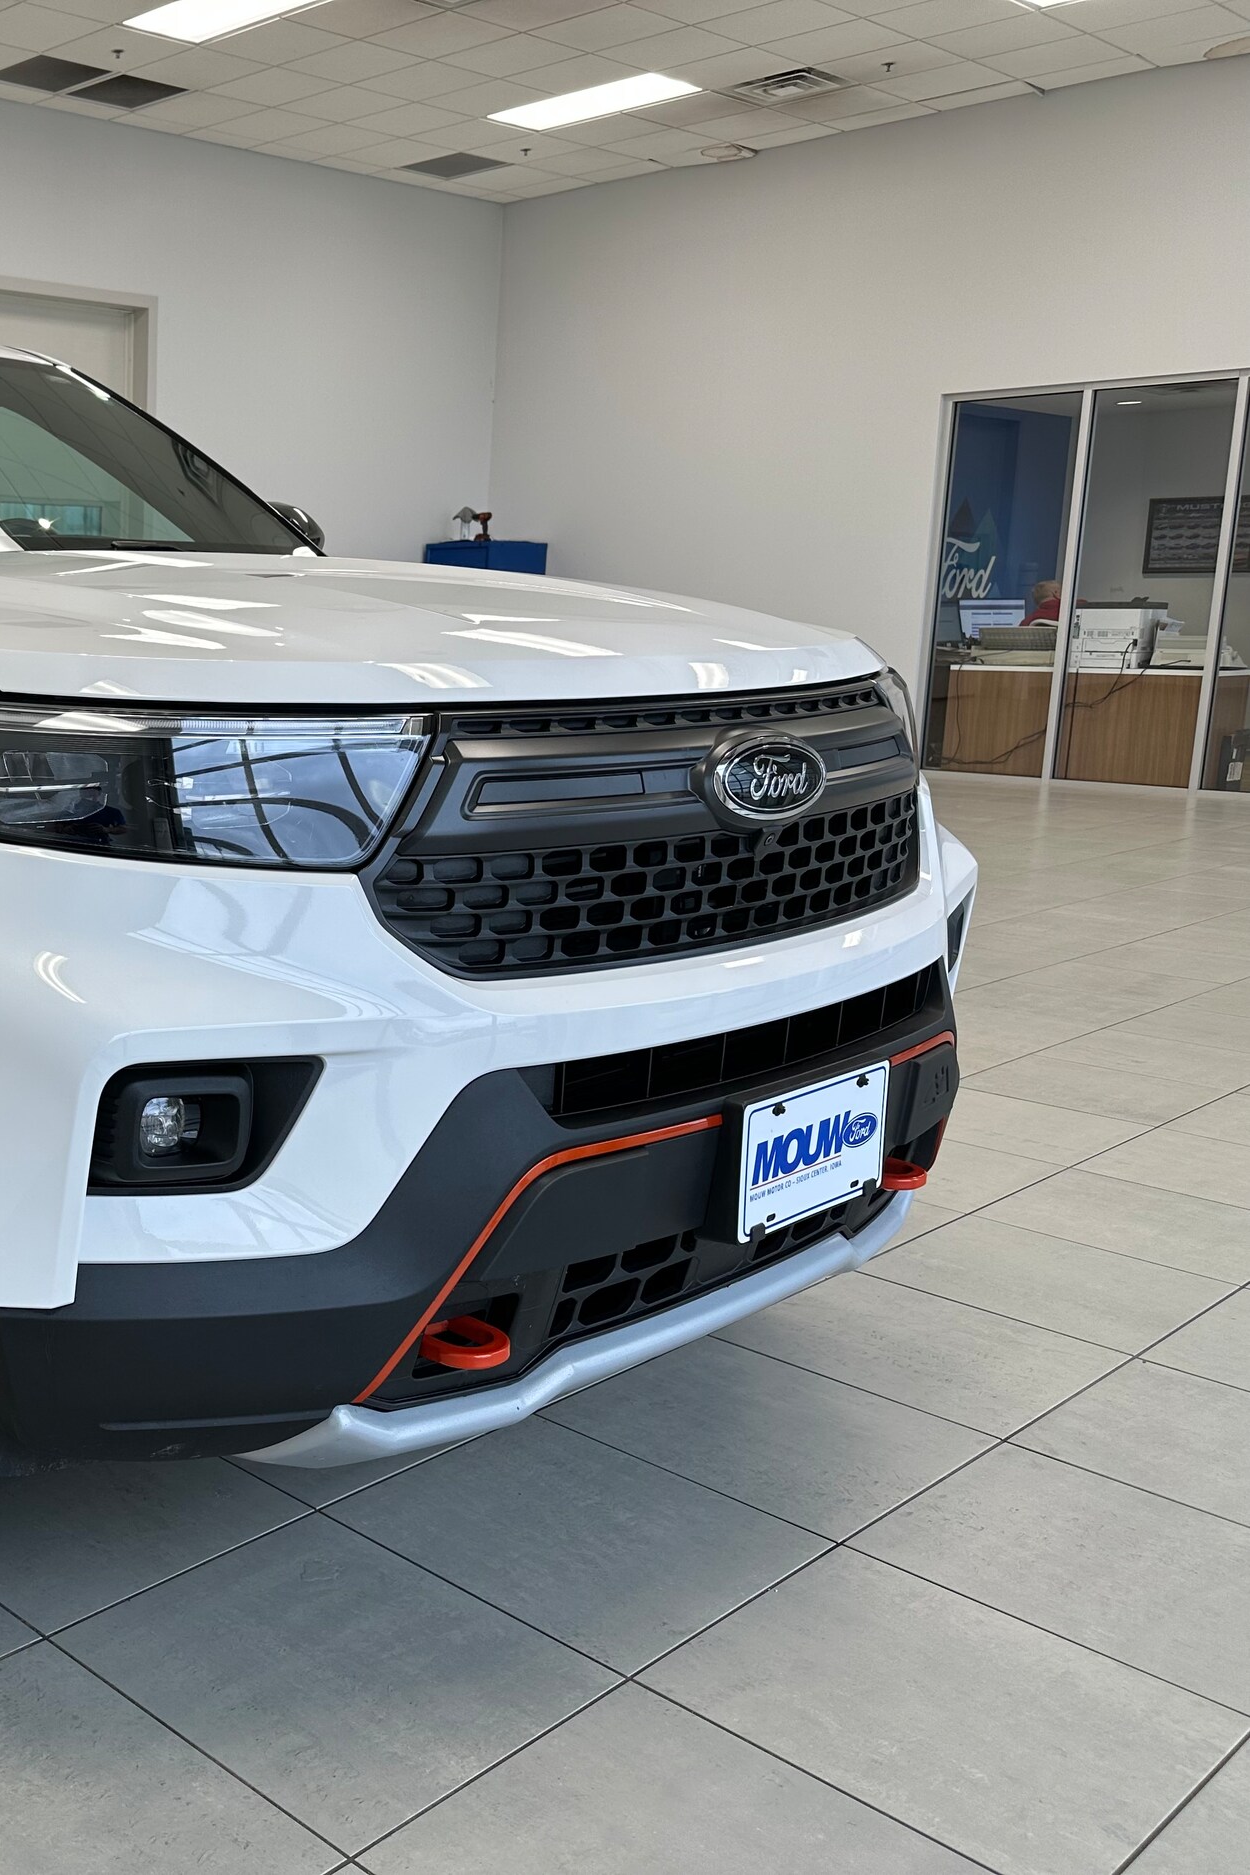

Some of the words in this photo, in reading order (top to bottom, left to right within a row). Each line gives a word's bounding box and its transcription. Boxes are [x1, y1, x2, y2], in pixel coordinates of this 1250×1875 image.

[942, 537, 996, 599] Ford
[749, 753, 809, 801] Ford
[751, 1109, 852, 1187] MOUW
[750, 1190, 767, 1203] MOUW
[767, 1183, 784, 1196] MOTOR
[785, 1179, 792, 1189] CO
[796, 1173, 810, 1185] SIOUX
